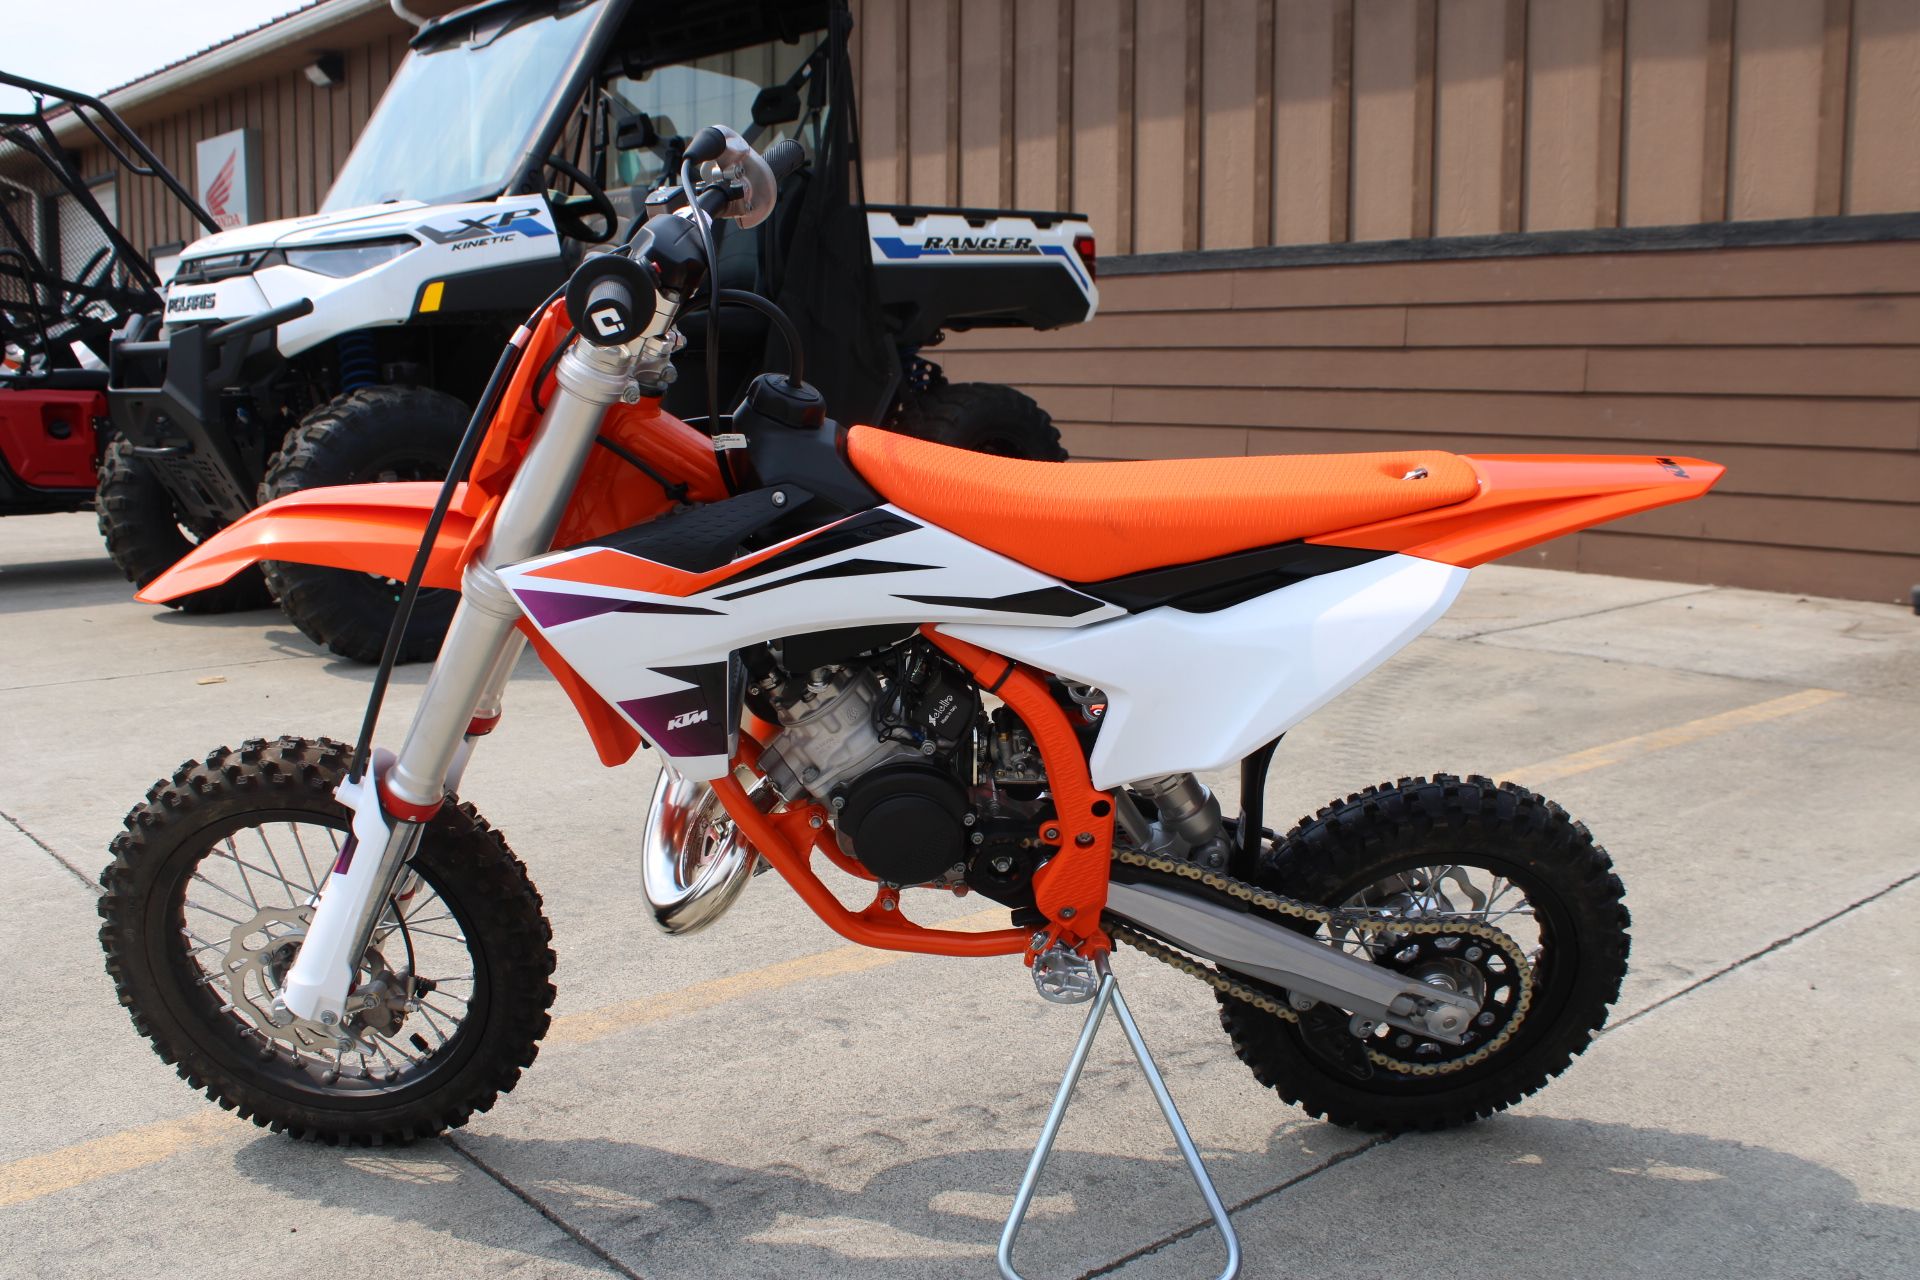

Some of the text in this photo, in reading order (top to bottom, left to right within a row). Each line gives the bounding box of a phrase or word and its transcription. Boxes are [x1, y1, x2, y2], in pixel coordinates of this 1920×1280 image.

[451, 233, 517, 252] KINETIC
[923, 236, 1033, 250] RANGER
[167, 292, 217, 313] POLARIS
[667, 709, 708, 731] KTM
